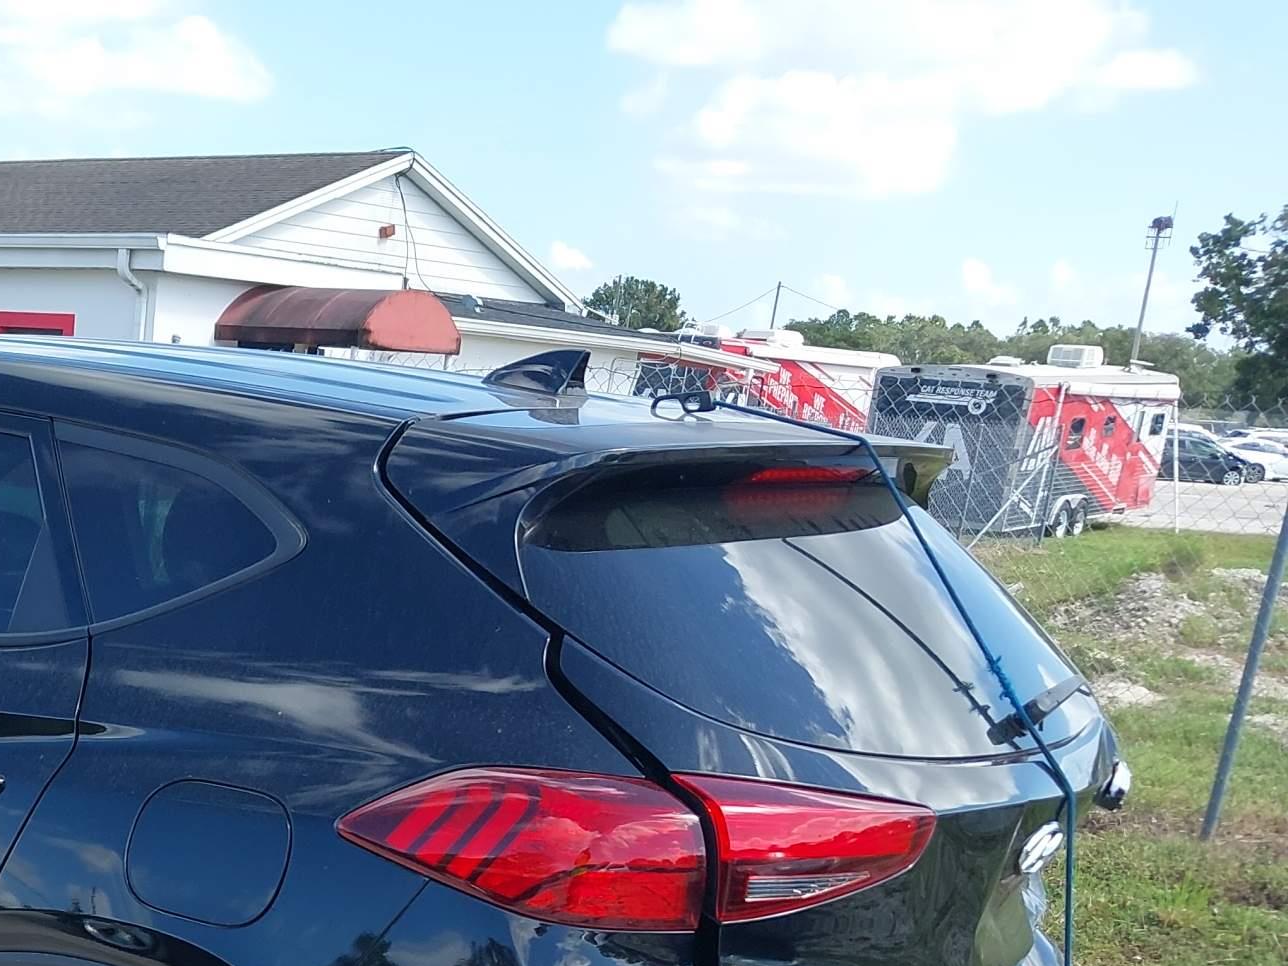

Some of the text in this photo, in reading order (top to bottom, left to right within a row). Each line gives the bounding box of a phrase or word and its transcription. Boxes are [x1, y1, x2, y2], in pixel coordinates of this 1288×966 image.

[921, 385, 998, 398] CAT RESPONSE TEAM
